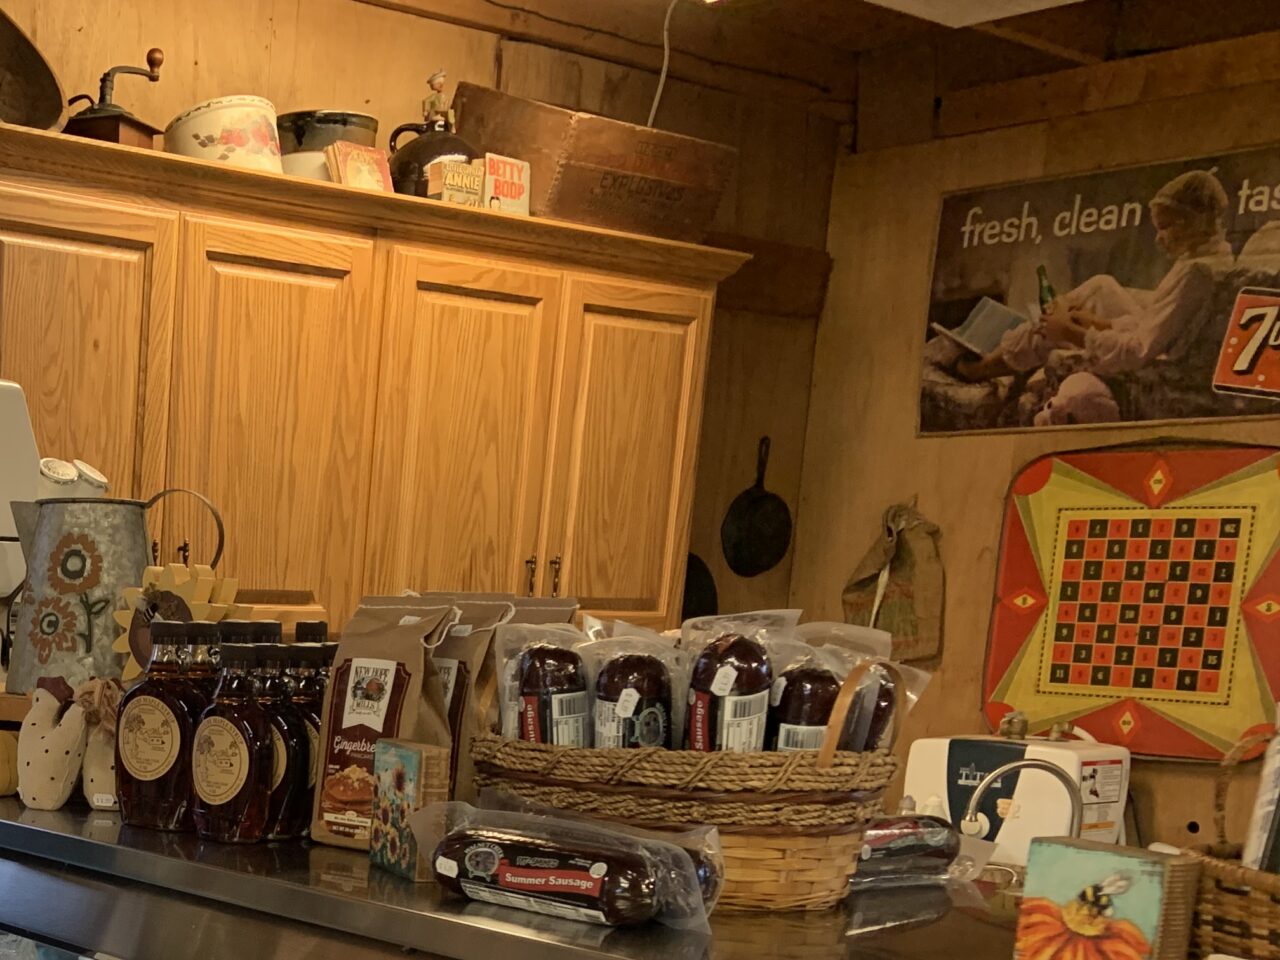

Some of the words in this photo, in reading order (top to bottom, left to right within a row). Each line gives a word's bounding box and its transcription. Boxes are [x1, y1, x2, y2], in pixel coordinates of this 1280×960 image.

[488, 158, 526, 178] BETTY
[444, 171, 481, 191] ANNIE
[493, 180, 525, 199] BOOP
[961, 201, 1043, 248] fresh,
[1053, 194, 1142, 237] clean
[354, 665, 371, 682] NEW
[372, 667, 391, 685] HOPE
[355, 701, 376, 710] MILLS
[527, 703, 536, 743] ausage
[695, 700, 704, 750] Sausage
[333, 735, 376, 755] Gingerbre
[505, 872, 547, 886] Summer
[548, 877, 594, 890] Sausage
